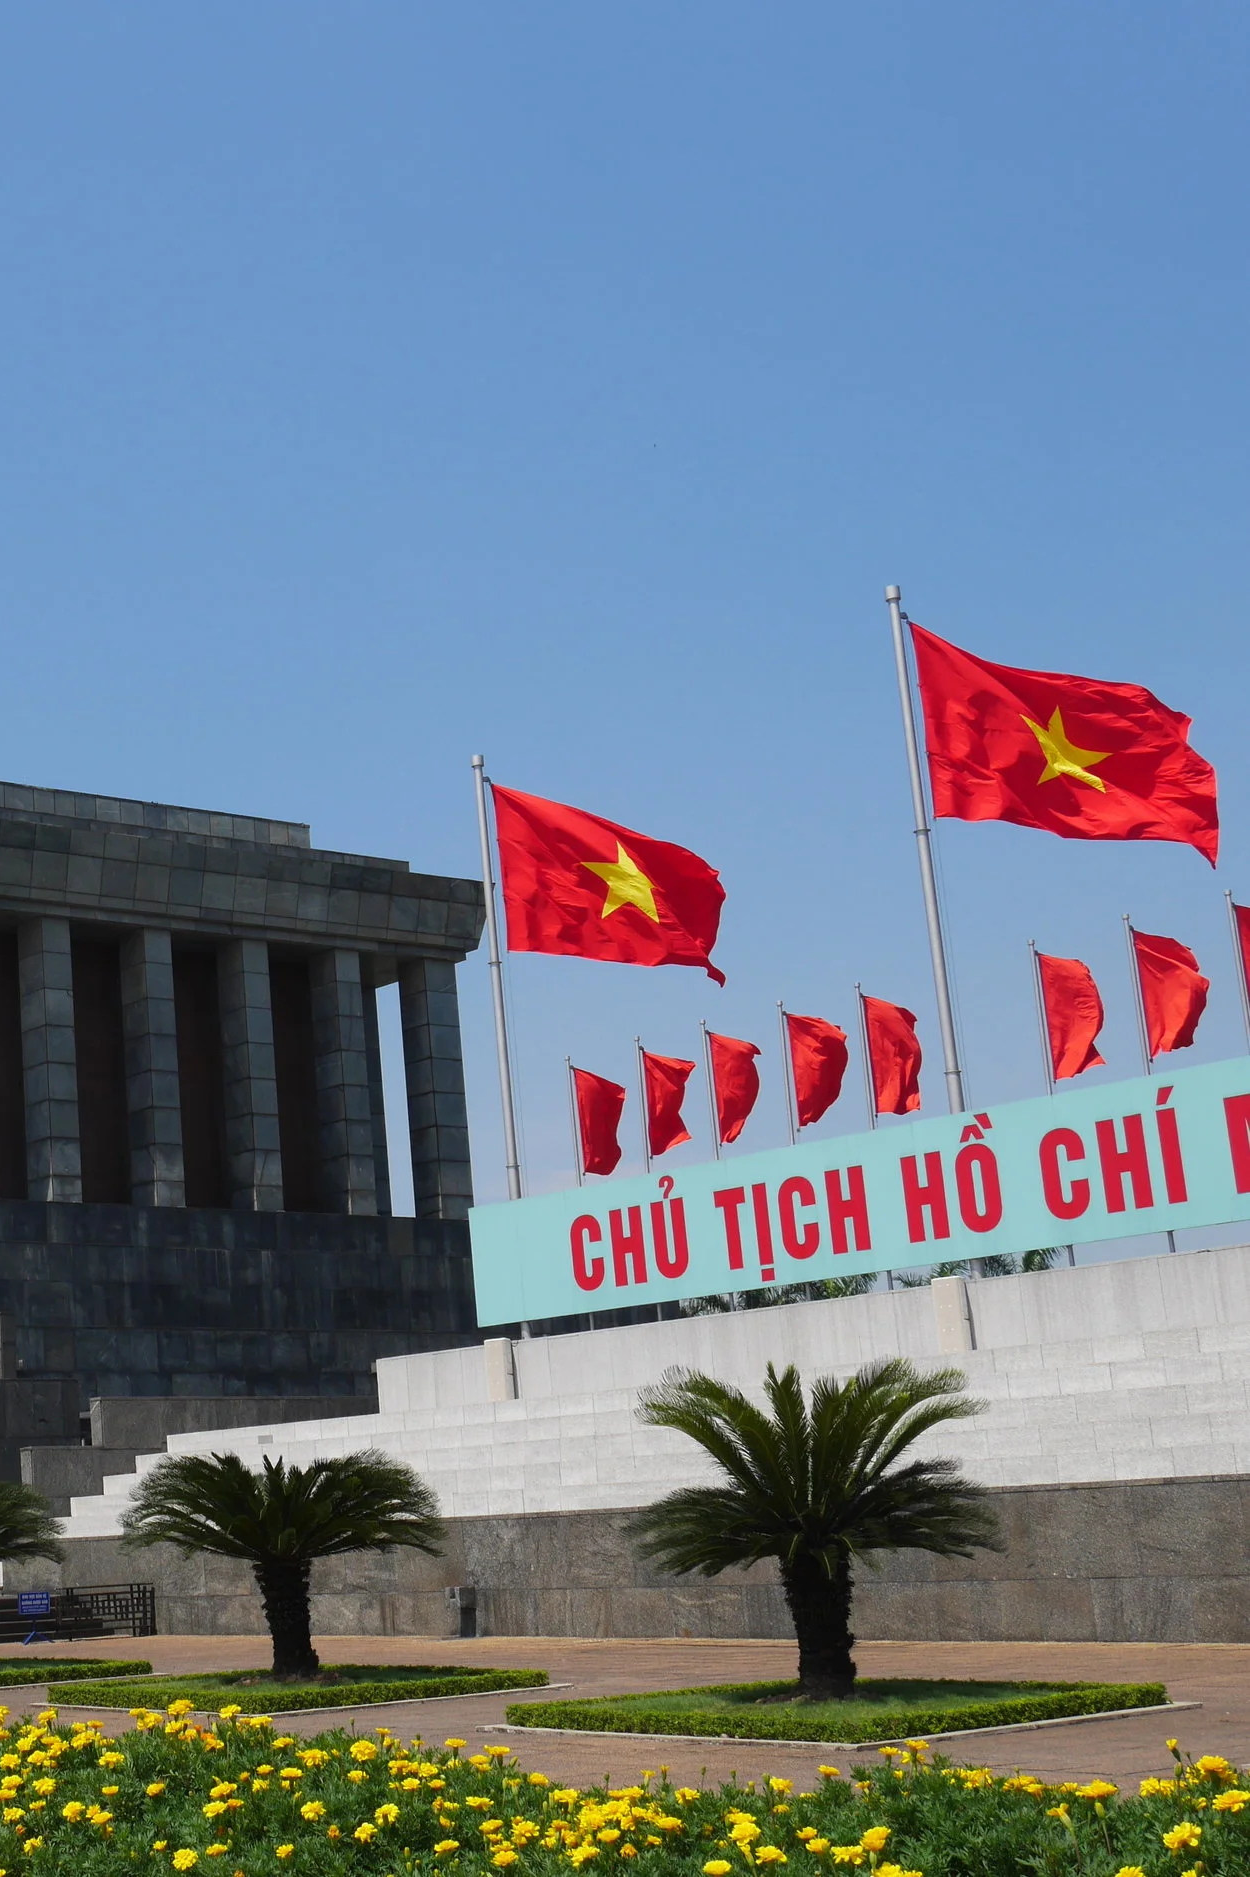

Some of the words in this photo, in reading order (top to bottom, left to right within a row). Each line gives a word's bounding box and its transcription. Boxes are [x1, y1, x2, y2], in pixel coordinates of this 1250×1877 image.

[570, 1176, 689, 1292] CHỦ
[713, 1166, 872, 1282] TỊCH
[900, 1113, 1003, 1244] HỒ
[1039, 1087, 1188, 1220] CHÍ
